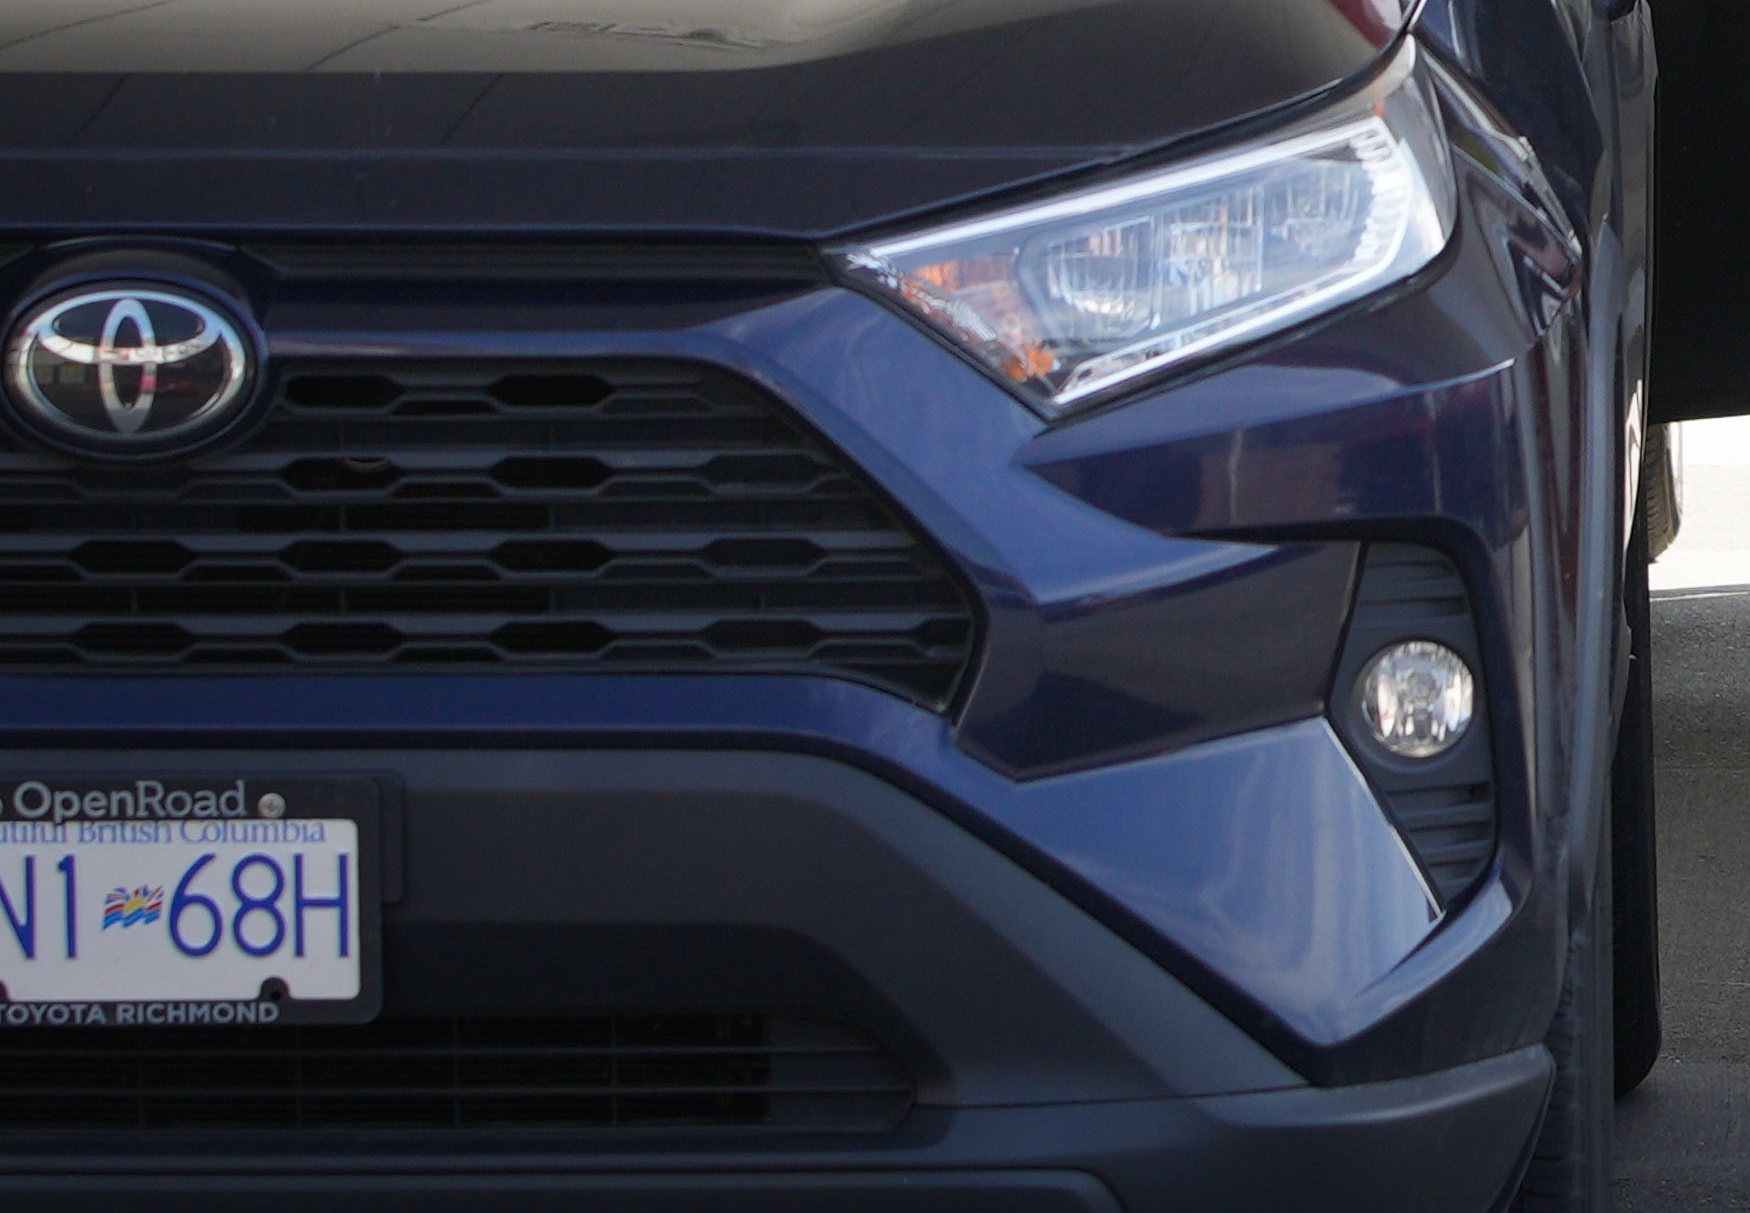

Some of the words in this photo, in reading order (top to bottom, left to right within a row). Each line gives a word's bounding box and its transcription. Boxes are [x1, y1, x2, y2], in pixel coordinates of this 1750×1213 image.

[13, 779, 246, 823] OpenRoad
[78, 821, 171, 844] British
[180, 821, 325, 844] Columbia
[168, 853, 349, 958] 68H
[117, 1002, 279, 1024] RICHMOND
